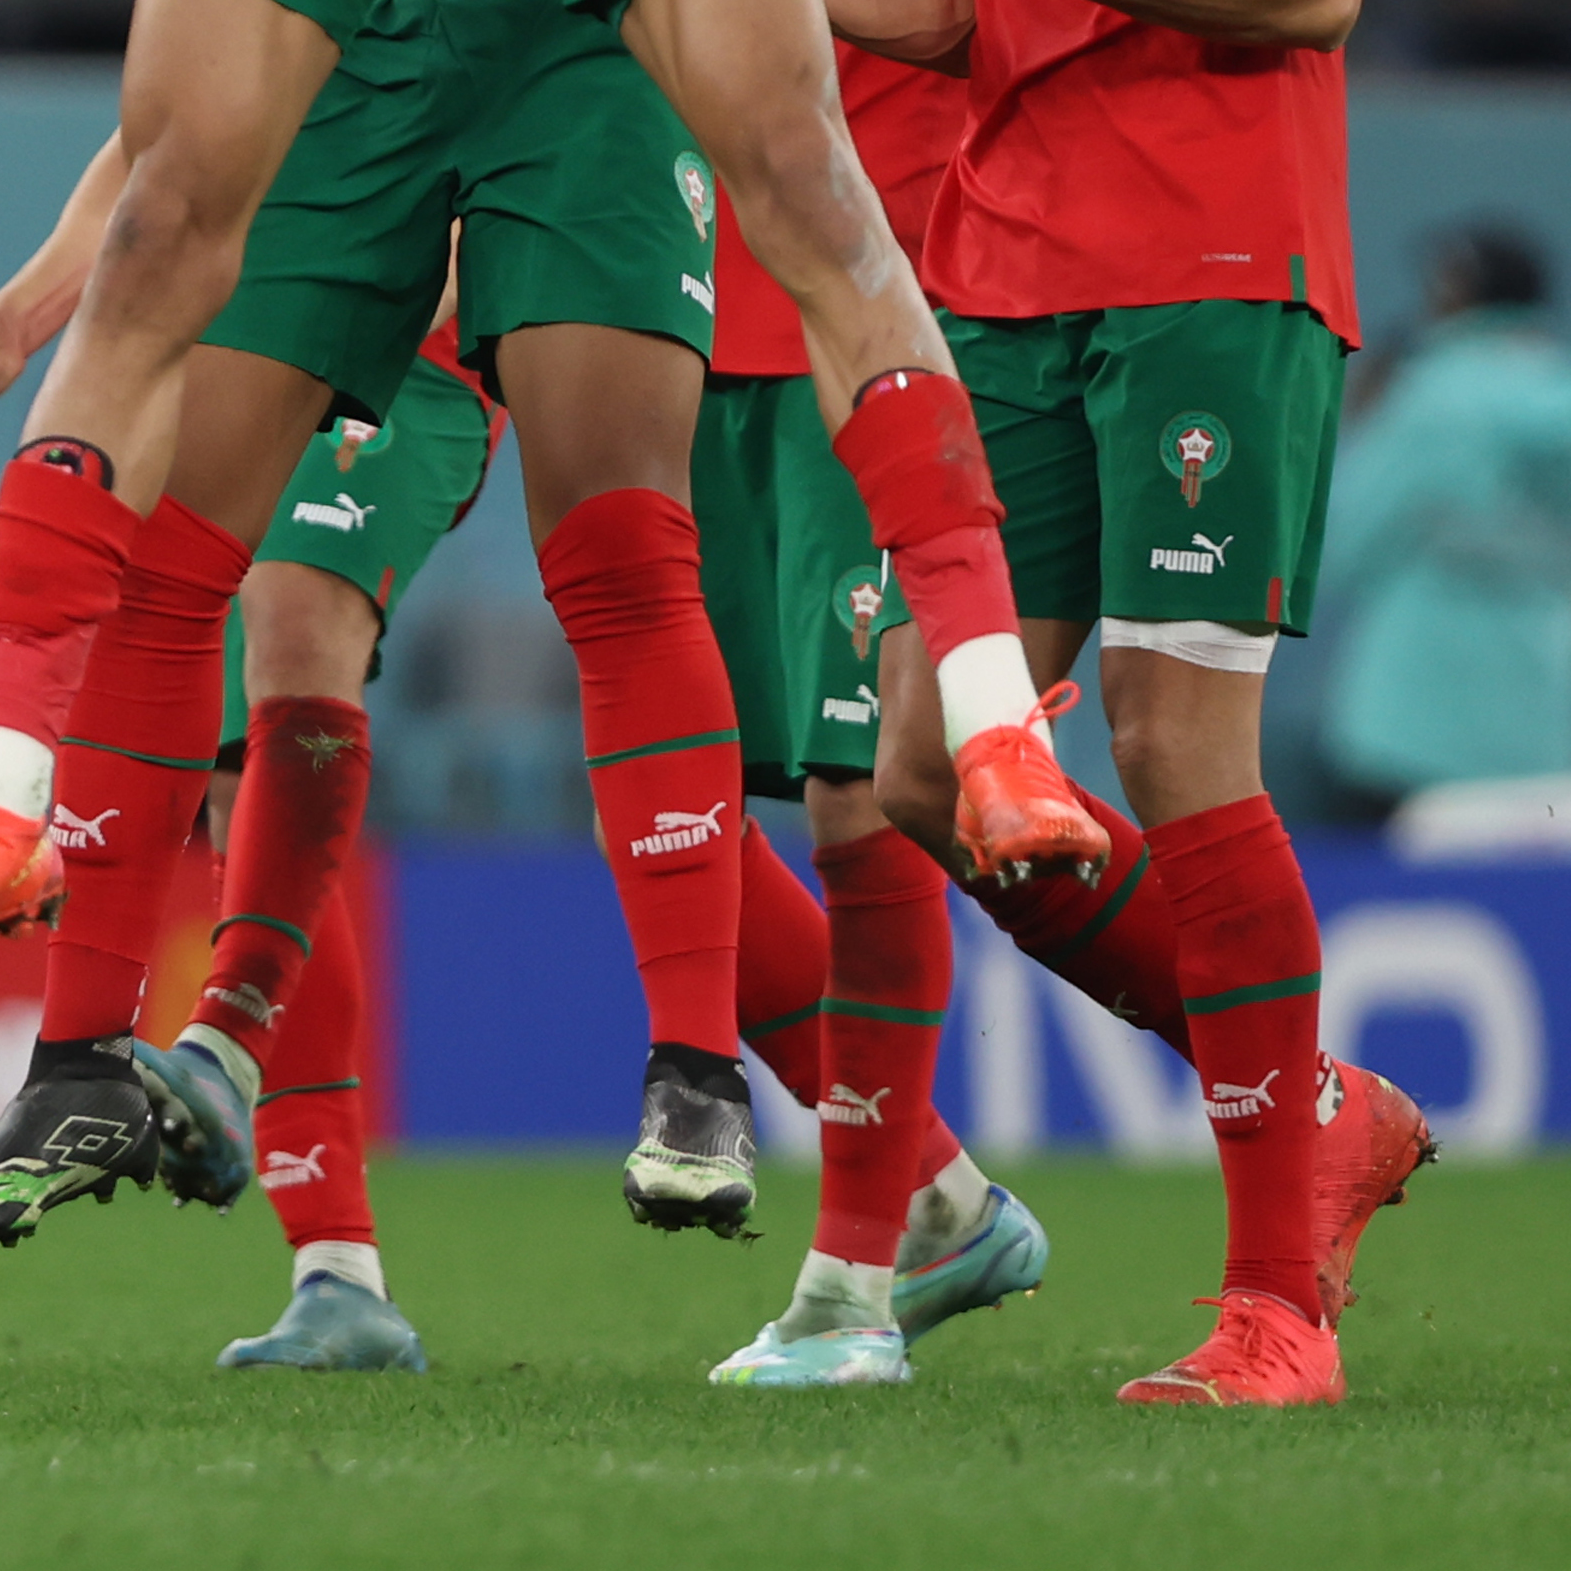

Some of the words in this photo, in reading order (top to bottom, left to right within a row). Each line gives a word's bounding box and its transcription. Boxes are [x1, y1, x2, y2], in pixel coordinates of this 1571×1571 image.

[1150, 548, 1214, 575] PUMA
[629, 825, 707, 857] PUMA
[1203, 1096, 1260, 1119] UMA
